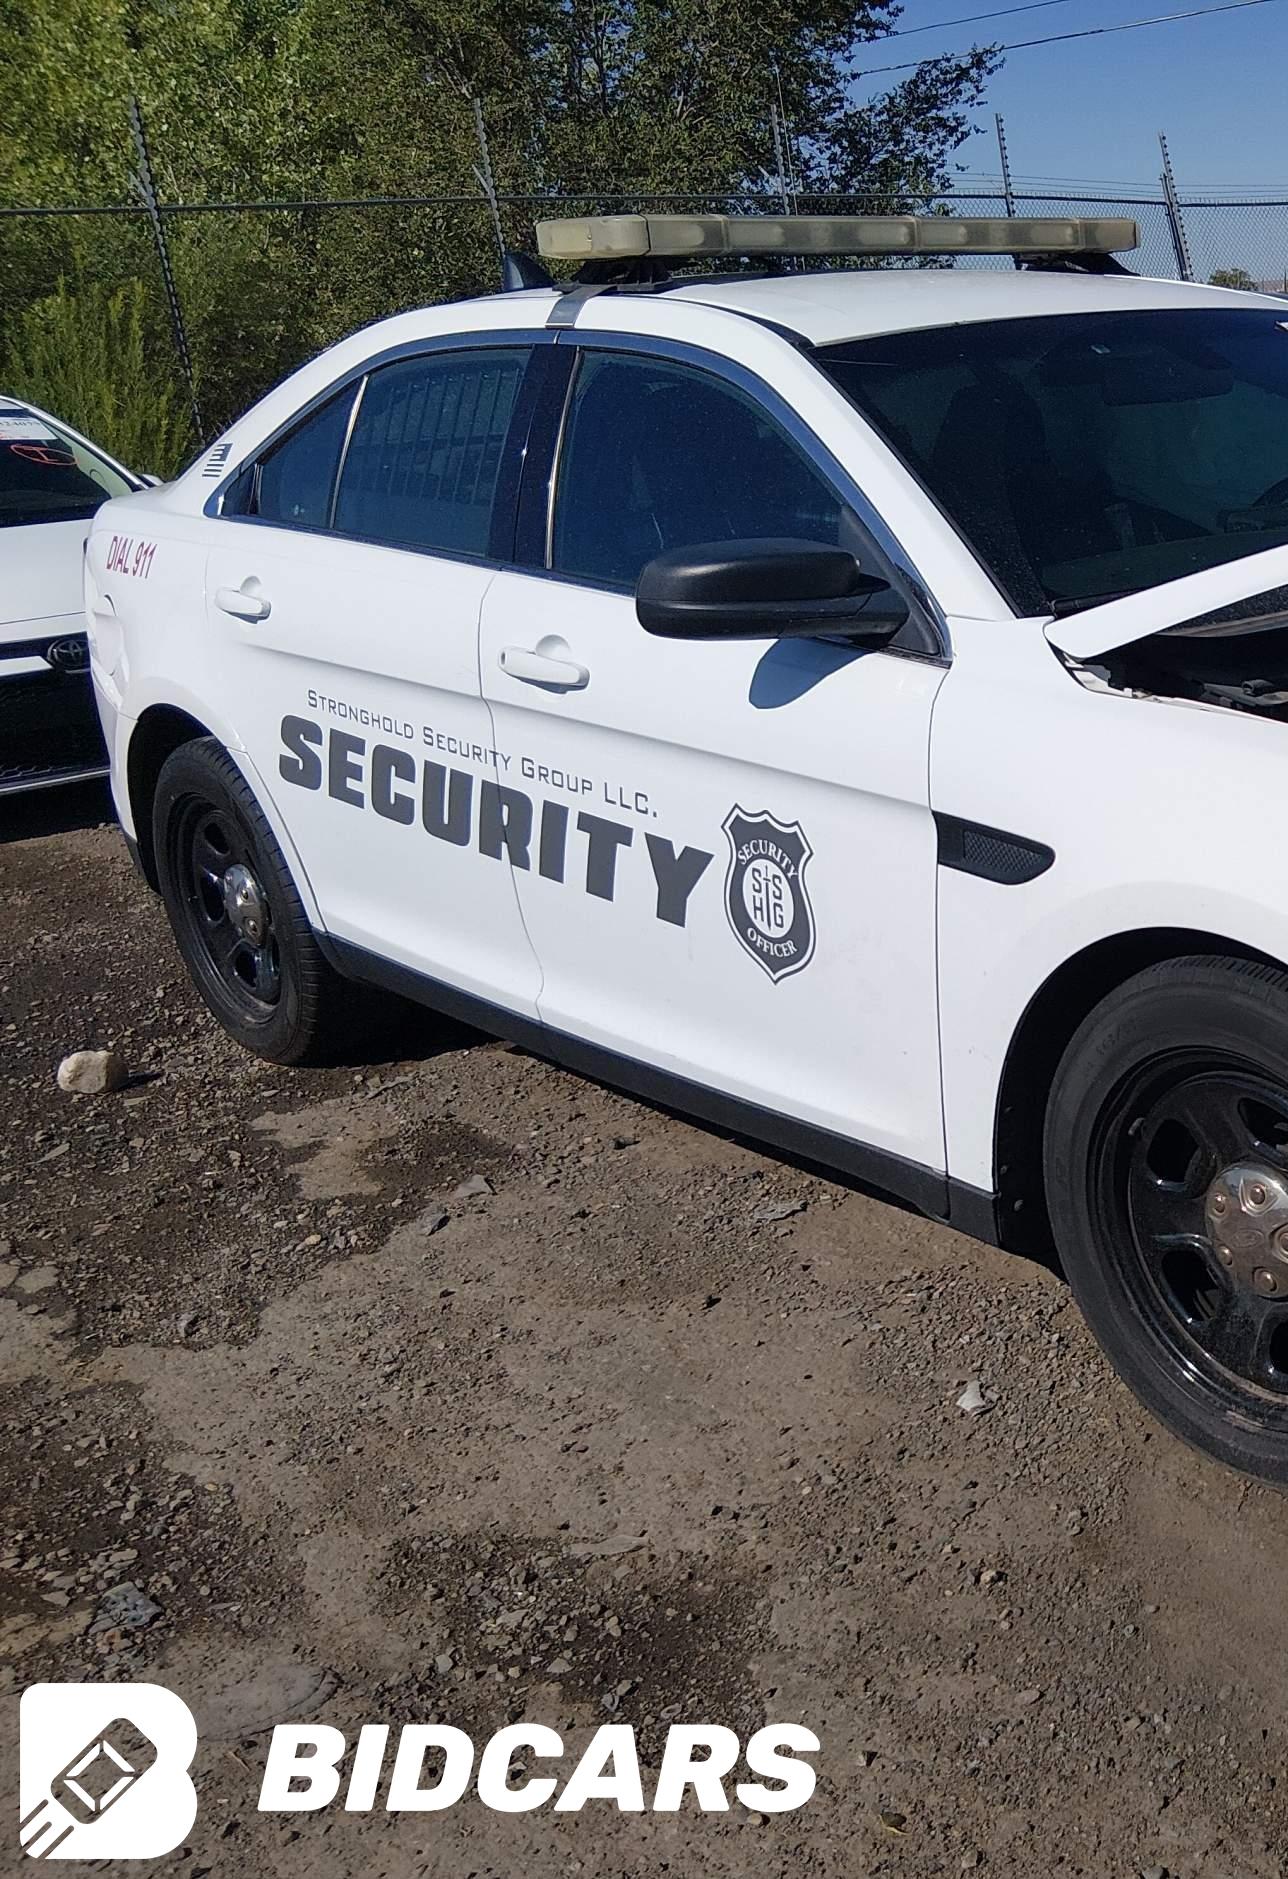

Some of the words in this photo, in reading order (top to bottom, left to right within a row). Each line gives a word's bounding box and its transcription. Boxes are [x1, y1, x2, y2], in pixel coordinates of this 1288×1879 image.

[106, 535, 134, 574] DIAL
[132, 541, 158, 580] 911
[307, 688, 415, 740] STRONGHOLD
[422, 726, 512, 771] SECURITY
[521, 756, 594, 796] GROUP
[278, 713, 715, 929] SECURITY
[737, 838, 799, 880] SECURITY
[746, 926, 798, 958] OFFICER
